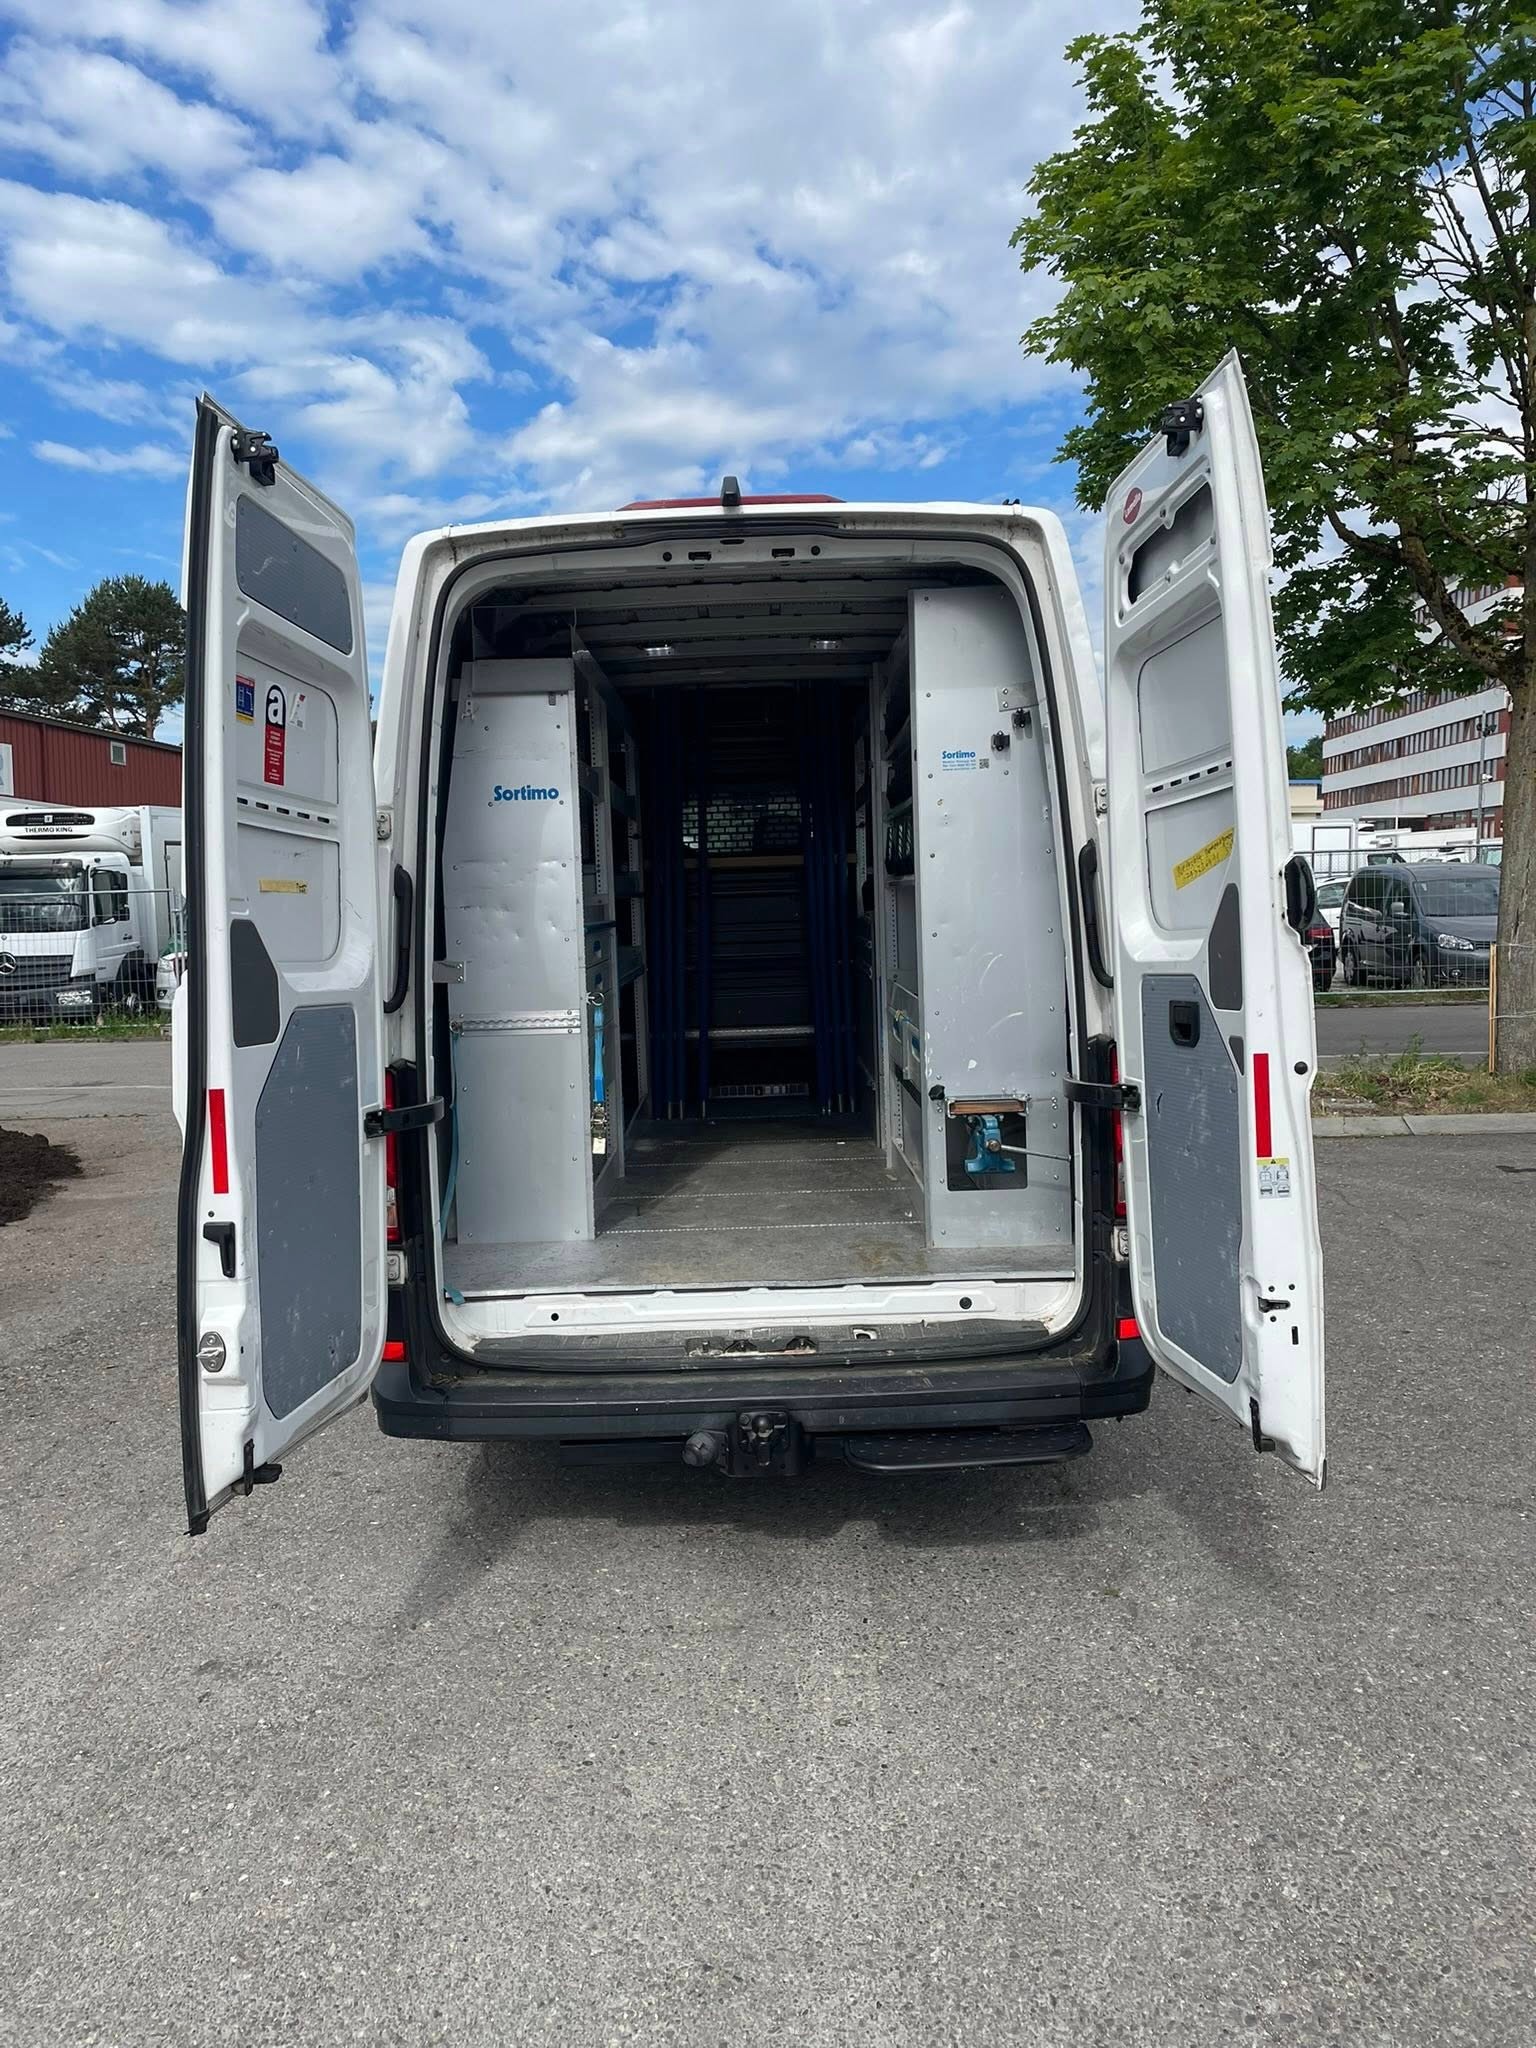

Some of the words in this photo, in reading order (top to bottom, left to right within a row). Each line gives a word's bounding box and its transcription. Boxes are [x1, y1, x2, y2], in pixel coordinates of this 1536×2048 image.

[268, 688, 284, 725] a
[942, 750, 976, 759] Sortimo
[493, 784, 560, 801] Sortimo
